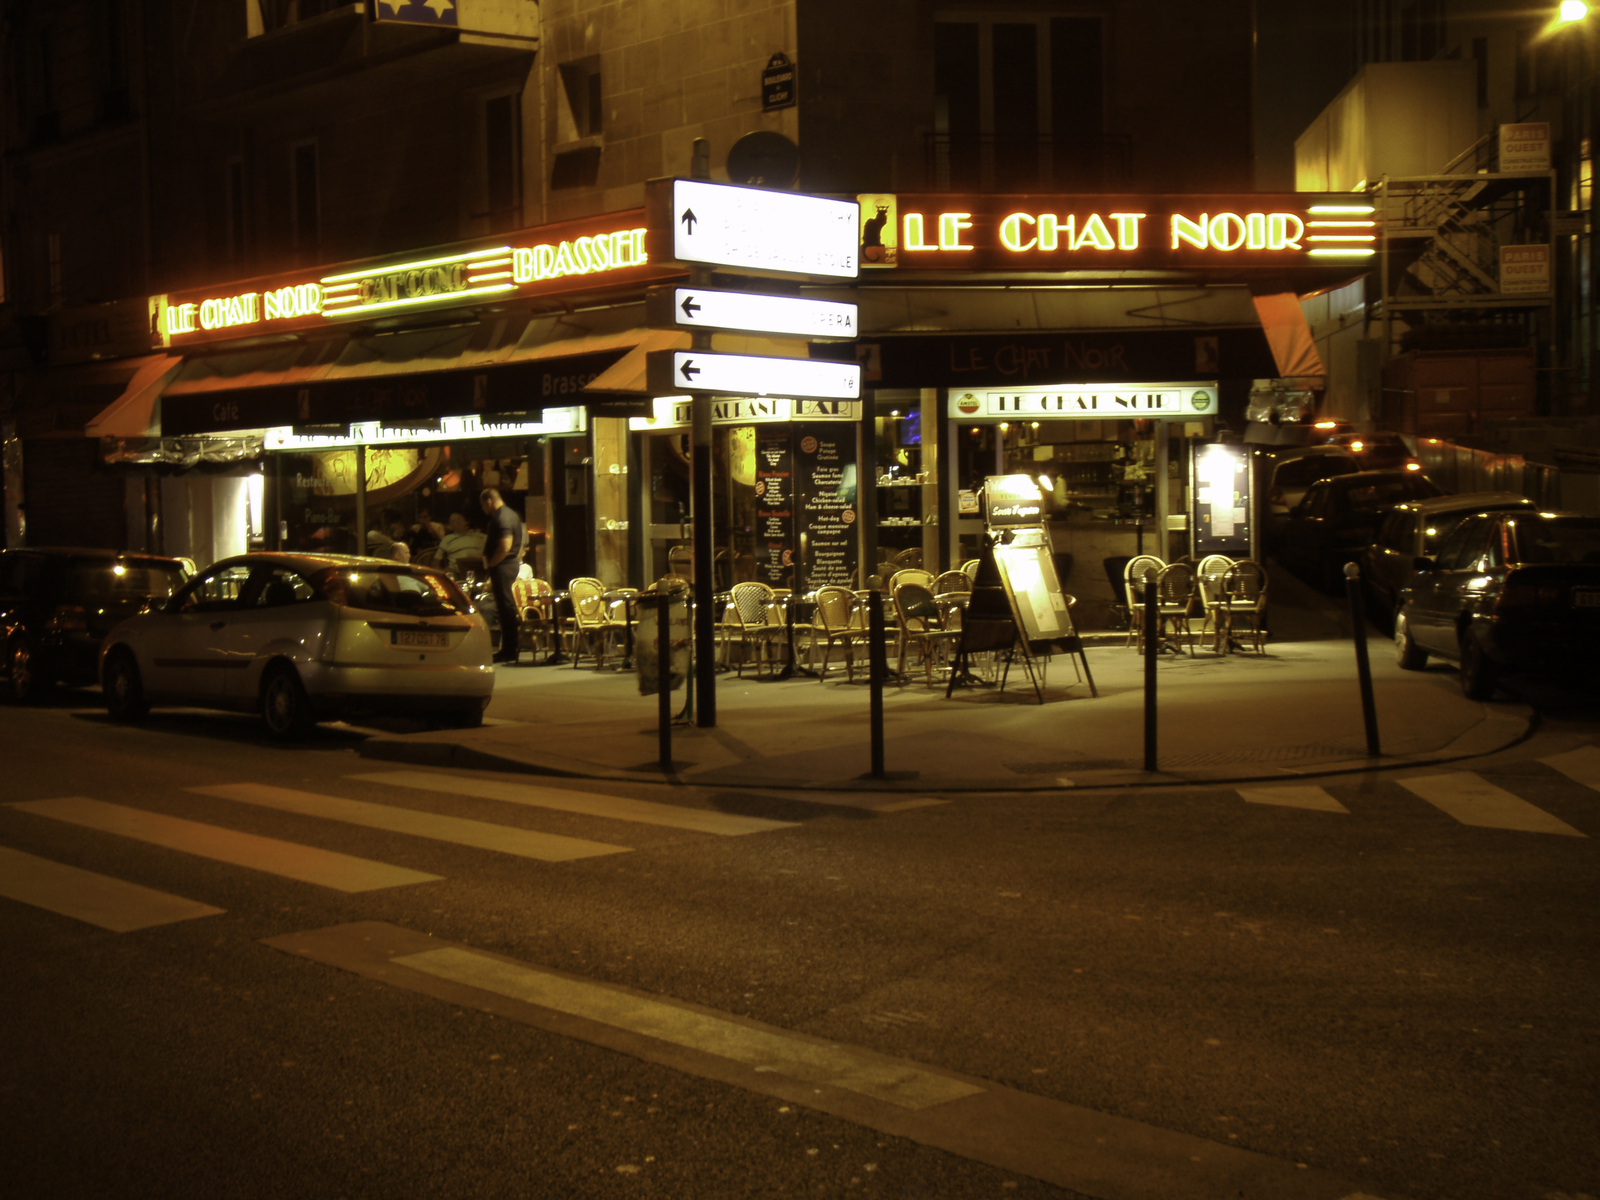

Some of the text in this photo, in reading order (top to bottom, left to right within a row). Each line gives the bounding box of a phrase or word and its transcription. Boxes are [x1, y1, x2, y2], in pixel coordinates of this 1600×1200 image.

[1505, 129, 1545, 140] PARIS
[1505, 143, 1544, 153] OUEST
[904, 212, 974, 252] LE
[1000, 212, 1147, 252] CHAT
[1172, 212, 1305, 252] NOIR
[1504, 251, 1545, 262] PARIS
[1505, 264, 1544, 274] OUEST
[167, 282, 324, 335] LE CHAT NOIR
[951, 341, 1130, 379] LE CHAT NOIR
[795, 400, 850, 415] BAR
[999, 393, 1171, 411] LE CHAT NOIR
[213, 402, 240, 423] Café
